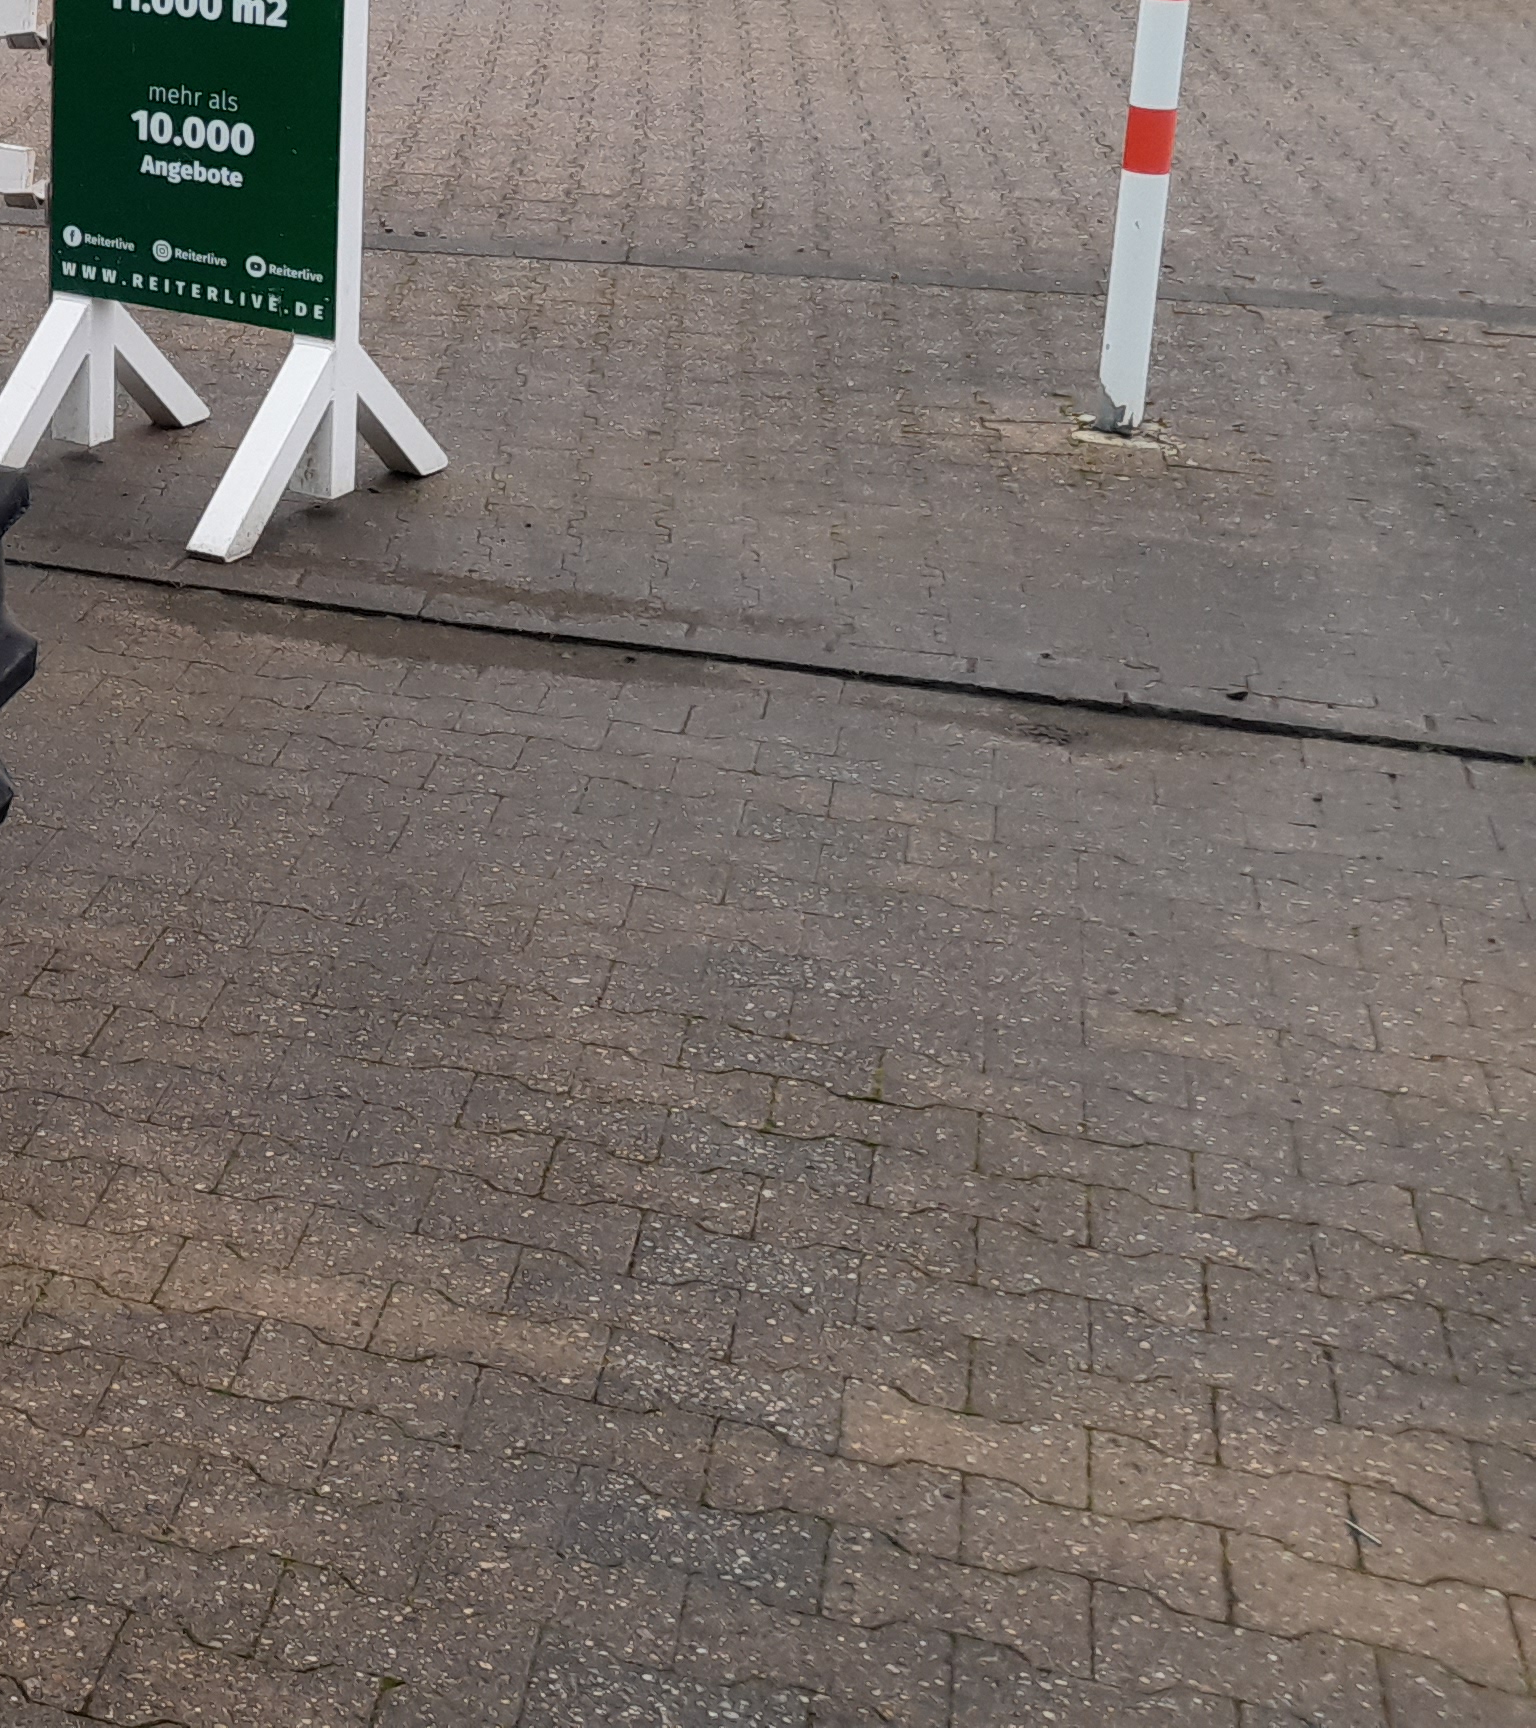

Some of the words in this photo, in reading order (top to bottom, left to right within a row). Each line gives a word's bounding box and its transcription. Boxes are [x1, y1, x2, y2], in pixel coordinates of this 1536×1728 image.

[148, 85, 203, 107] mehr
[208, 89, 239, 112] als
[130, 109, 255, 156] 10.000
[140, 154, 244, 188] Angebote
[84, 232, 135, 252] Reiterlive
[174, 247, 228, 267] Reiterlive
[268, 263, 324, 283] Reiterlive
